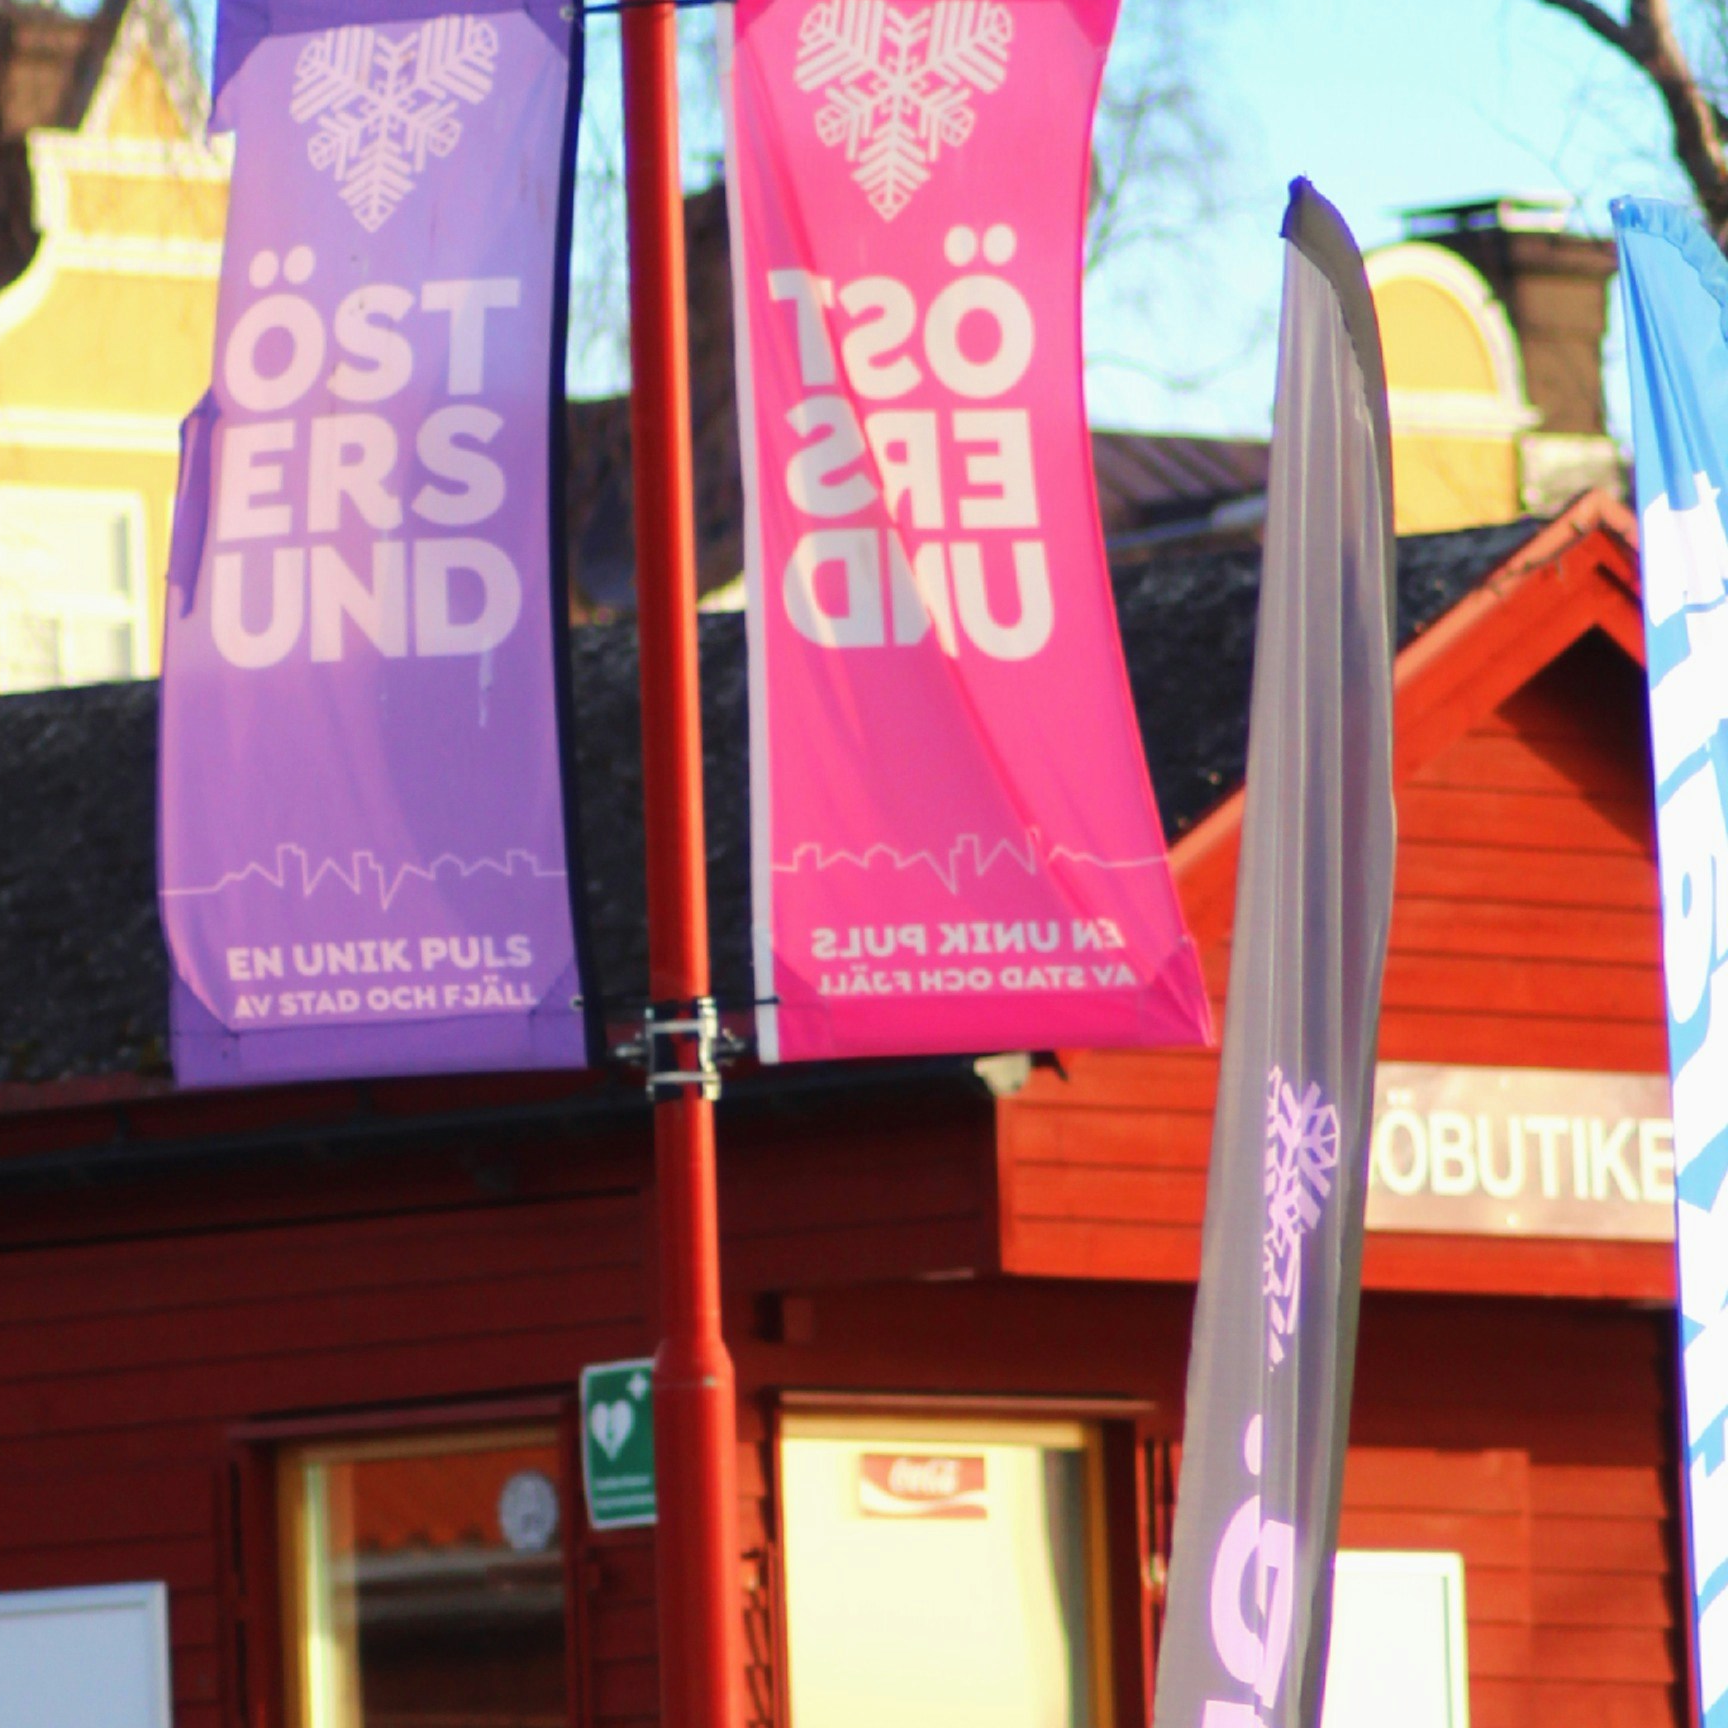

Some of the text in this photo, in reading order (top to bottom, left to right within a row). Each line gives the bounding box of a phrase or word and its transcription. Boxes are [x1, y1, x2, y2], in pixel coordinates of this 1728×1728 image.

[223, 245, 521, 413] ÖST
[216, 405, 505, 542] ERS
[210, 536, 522, 669] UND
[226, 934, 533, 981] EN UNIK PULS
[234, 974, 540, 1019] AV STAD OCH FJÄLL
[1371, 1088, 1673, 1202] ÖBUTIKE
